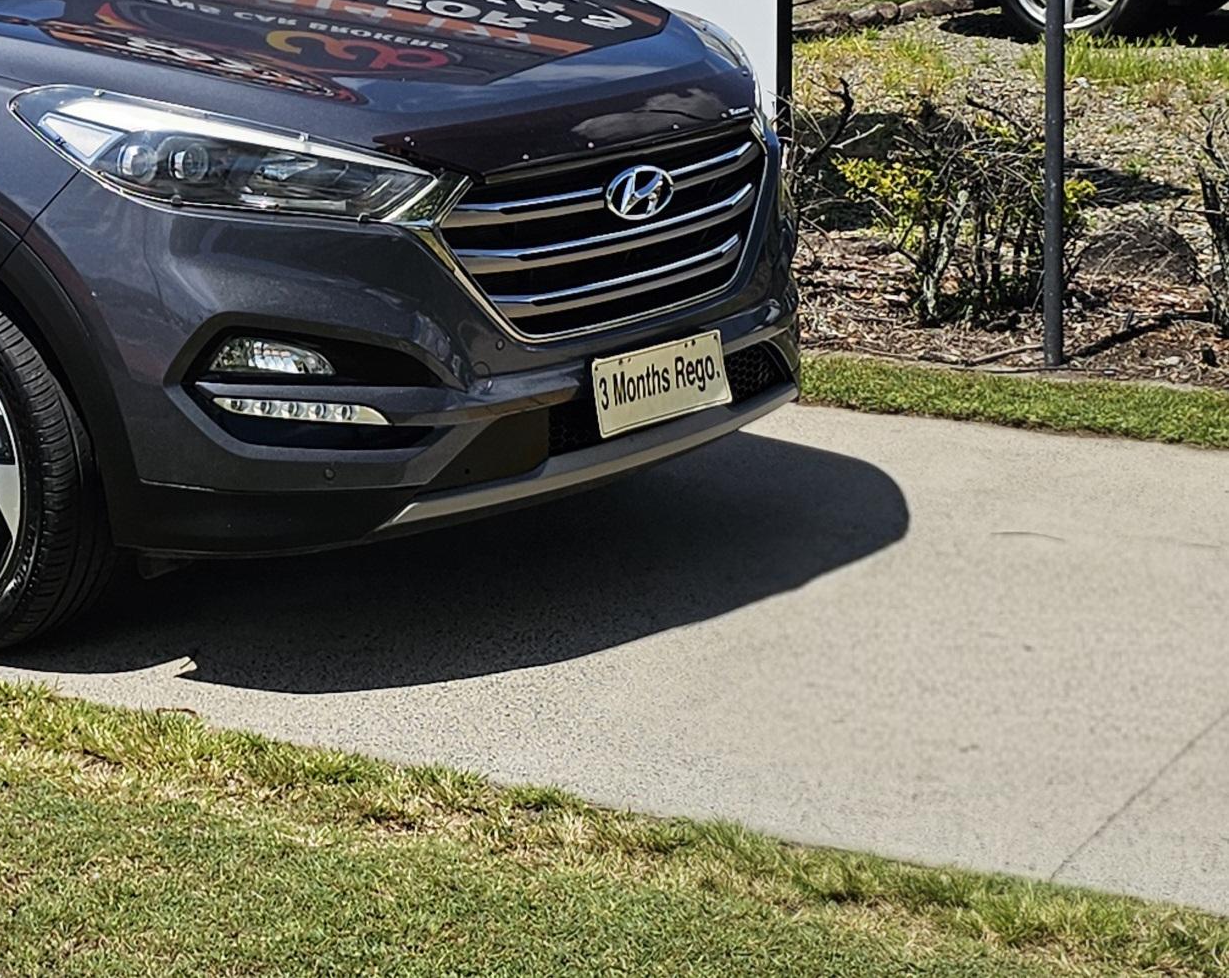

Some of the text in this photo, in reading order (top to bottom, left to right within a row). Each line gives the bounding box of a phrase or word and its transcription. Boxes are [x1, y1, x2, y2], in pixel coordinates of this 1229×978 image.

[599, 355, 721, 410] 3 Months Rego.
